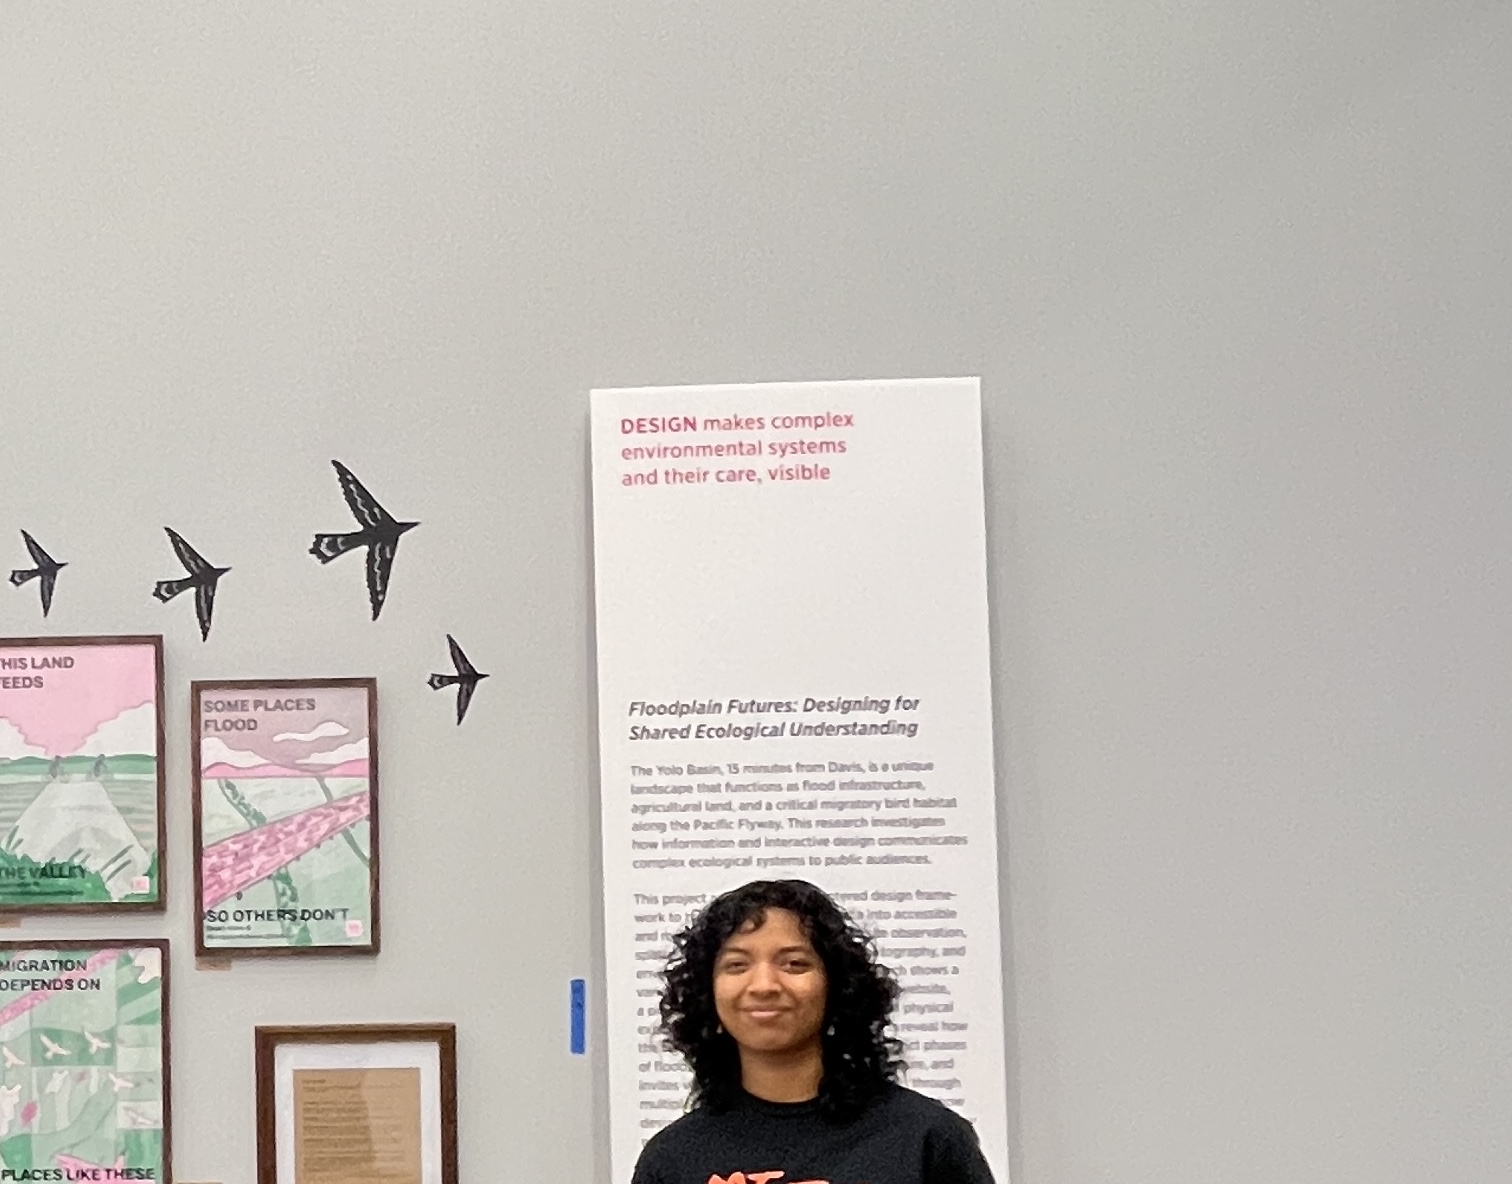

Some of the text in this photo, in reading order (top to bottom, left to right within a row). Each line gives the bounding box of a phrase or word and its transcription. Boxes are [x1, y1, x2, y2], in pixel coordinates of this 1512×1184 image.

[620, 411, 855, 434] DESIGN makes complex
[621, 438, 846, 460] environmental systems
[622, 463, 831, 486] and their care, visible
[31, 656, 75, 670] LAND
[204, 698, 316, 713] SOME PLACES
[628, 695, 920, 719] Floodplain Futures: Designing for
[204, 719, 258, 732] FLOOD
[628, 720, 919, 741] Shared Ecological Understanding
[631, 765, 653, 776] The
[795, 762, 825, 773] from
[697, 782, 721, 793] that
[802, 780, 835, 791] flood
[739, 800, 762, 811] and
[670, 820, 690, 830] the
[787, 817, 812, 828] This
[738, 837, 762, 848] and
[688, 855, 753, 869] ecological
[30, 864, 86, 879] VALLEY
[207, 907, 350, 923] SO OTHERS DON'T
[78, 978, 101, 991] ON
[1, 1167, 155, 1182] PLACES LIKE THESE
